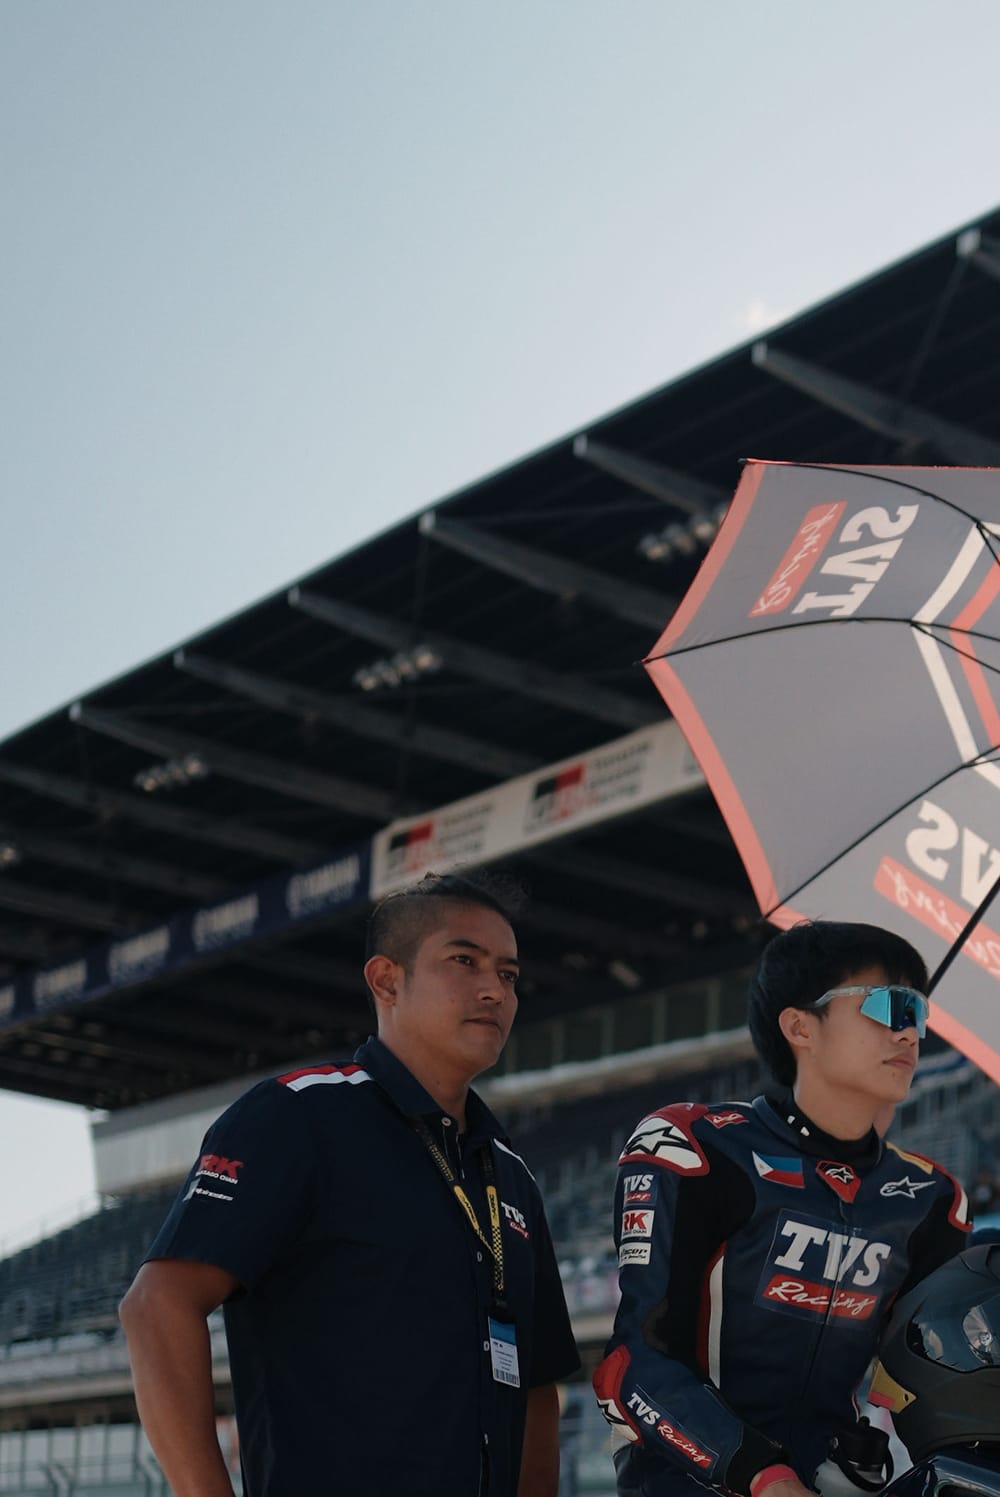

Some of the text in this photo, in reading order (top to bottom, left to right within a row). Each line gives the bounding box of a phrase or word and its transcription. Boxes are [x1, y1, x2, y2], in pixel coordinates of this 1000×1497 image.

[623, 1173, 655, 1195] TVS
[500, 1200, 528, 1229] TVS
[774, 1219, 892, 1287] TVS
[769, 1280, 876, 1316] Racing
[627, 1392, 661, 1425] TVS
